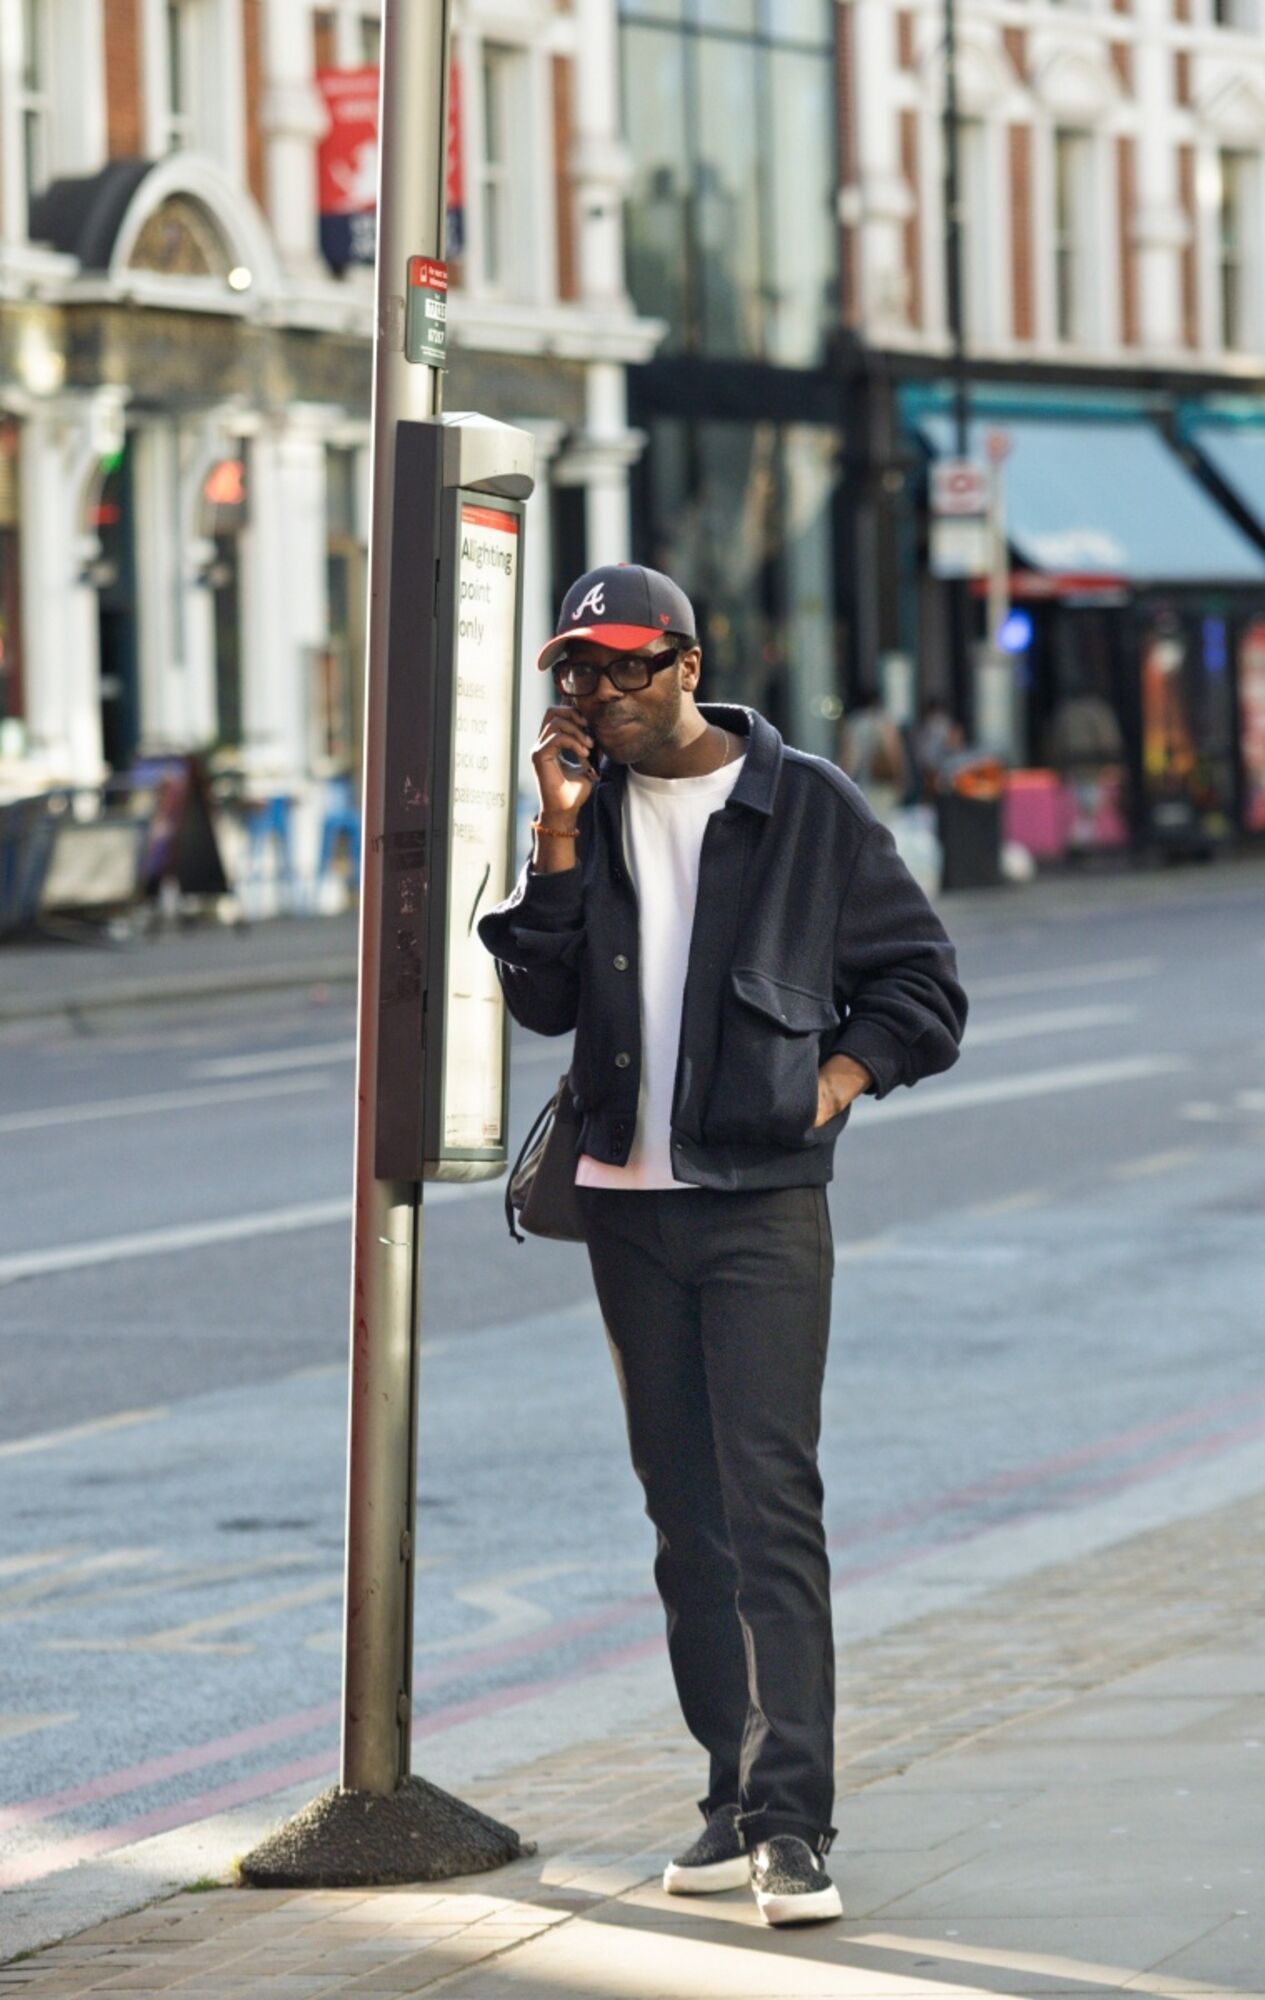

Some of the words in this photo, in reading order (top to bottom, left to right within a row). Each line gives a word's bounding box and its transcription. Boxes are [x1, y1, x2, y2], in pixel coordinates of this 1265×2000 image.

[461, 537, 513, 576] Alighting
[460, 579, 492, 606] point
[572, 582, 606, 621] A
[458, 616, 486, 645] only
[456, 675, 486, 699] Buses
[455, 714, 470, 734] do
[471, 716, 489, 735] not
[477, 753, 490, 773] up
[453, 785, 507, 811] passengers
